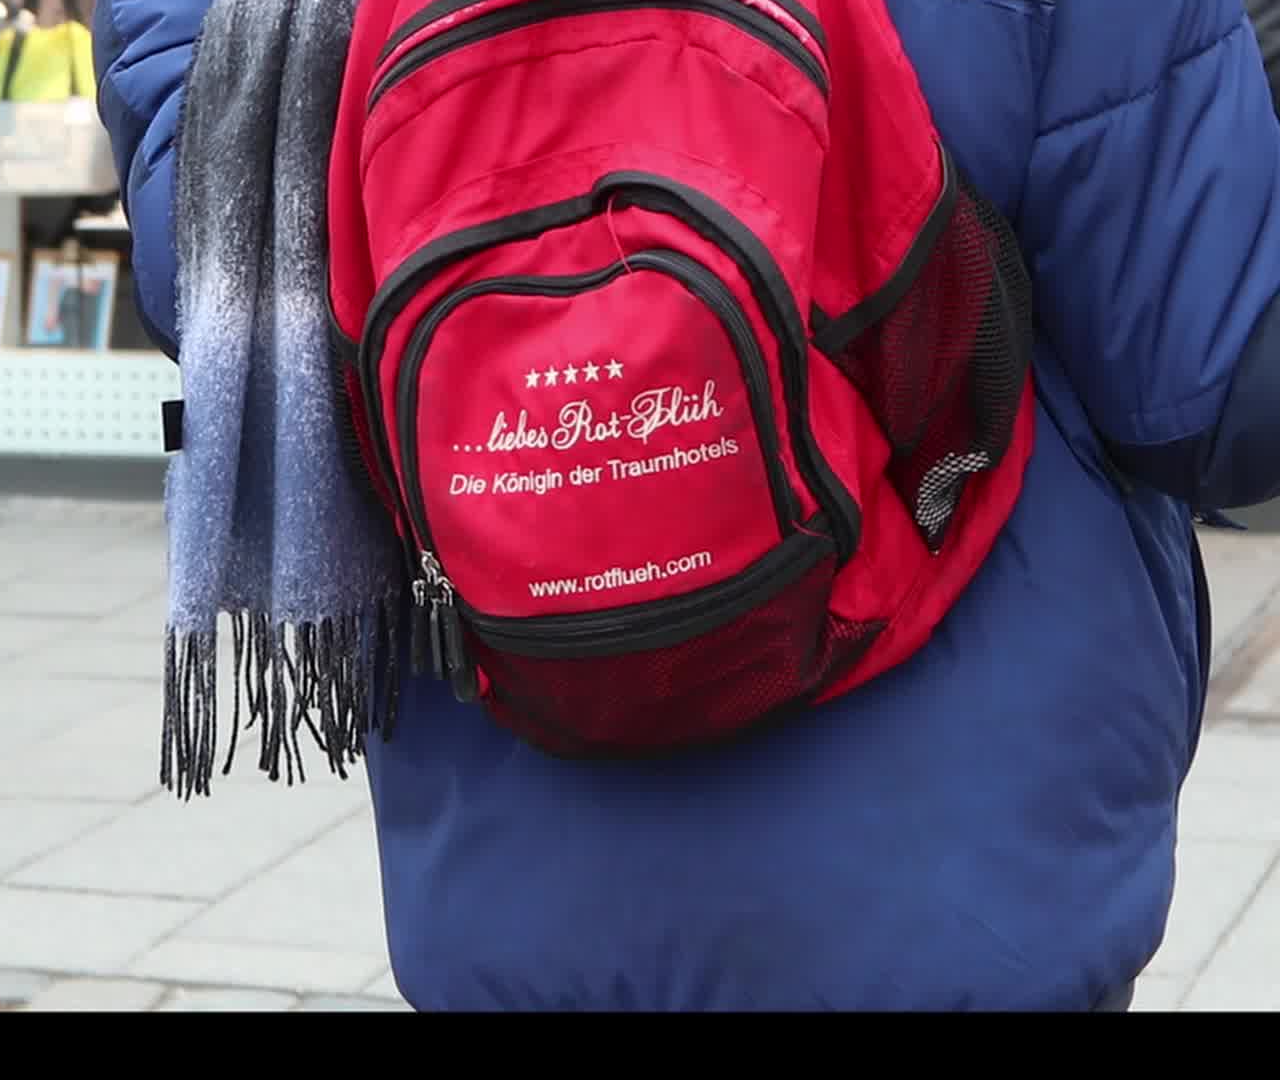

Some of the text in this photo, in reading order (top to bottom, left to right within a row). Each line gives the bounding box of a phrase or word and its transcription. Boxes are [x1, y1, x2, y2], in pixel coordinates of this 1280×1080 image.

[450, 438, 738, 495] Die Königin der Traumhotels
[530, 552, 710, 596] www.rotflueh.com
